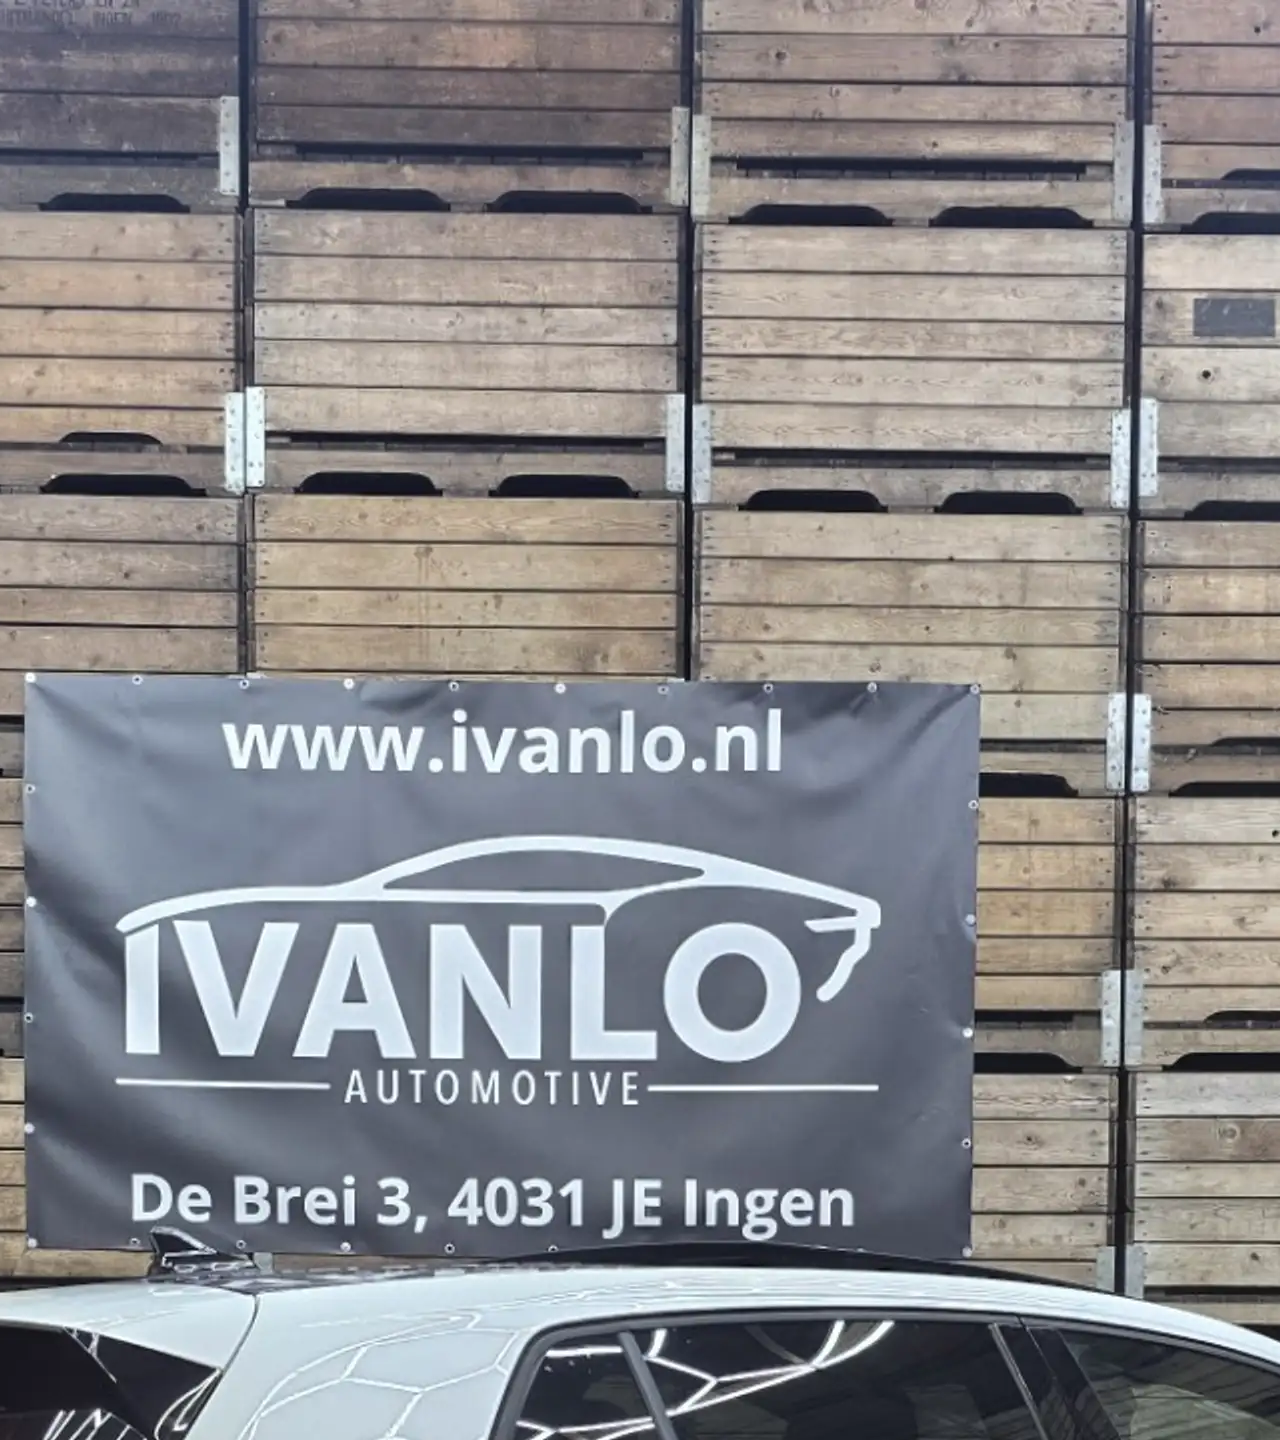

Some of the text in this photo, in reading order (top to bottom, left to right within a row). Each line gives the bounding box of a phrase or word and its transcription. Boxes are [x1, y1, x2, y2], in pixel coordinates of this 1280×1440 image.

[221, 709, 782, 774] www.ivanlo.nl
[125, 919, 801, 1062] IVANLO
[344, 1069, 639, 1106] AUTOMOTIVE
[132, 1174, 853, 1241] De Brei 3, 4031 JE Ingen
